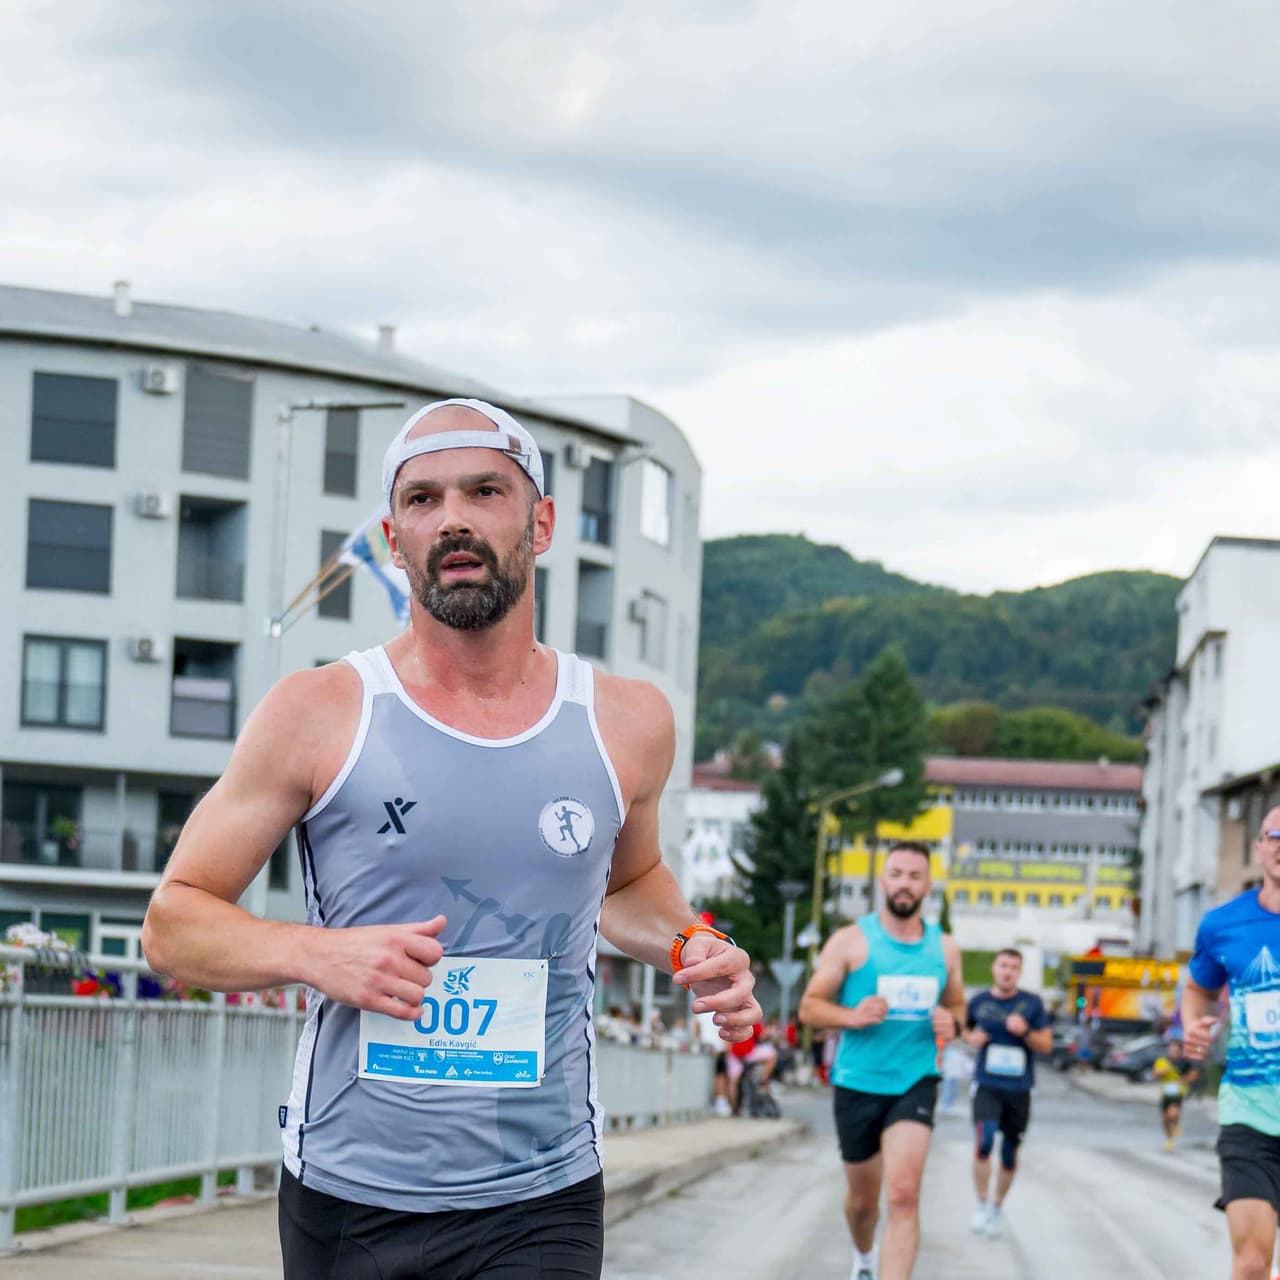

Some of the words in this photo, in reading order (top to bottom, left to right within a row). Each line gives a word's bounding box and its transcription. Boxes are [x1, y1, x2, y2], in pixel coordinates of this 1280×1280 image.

[447, 966, 476, 985] 5K
[413, 997, 498, 1036] 007
[429, 1039, 447, 1047] Edis
